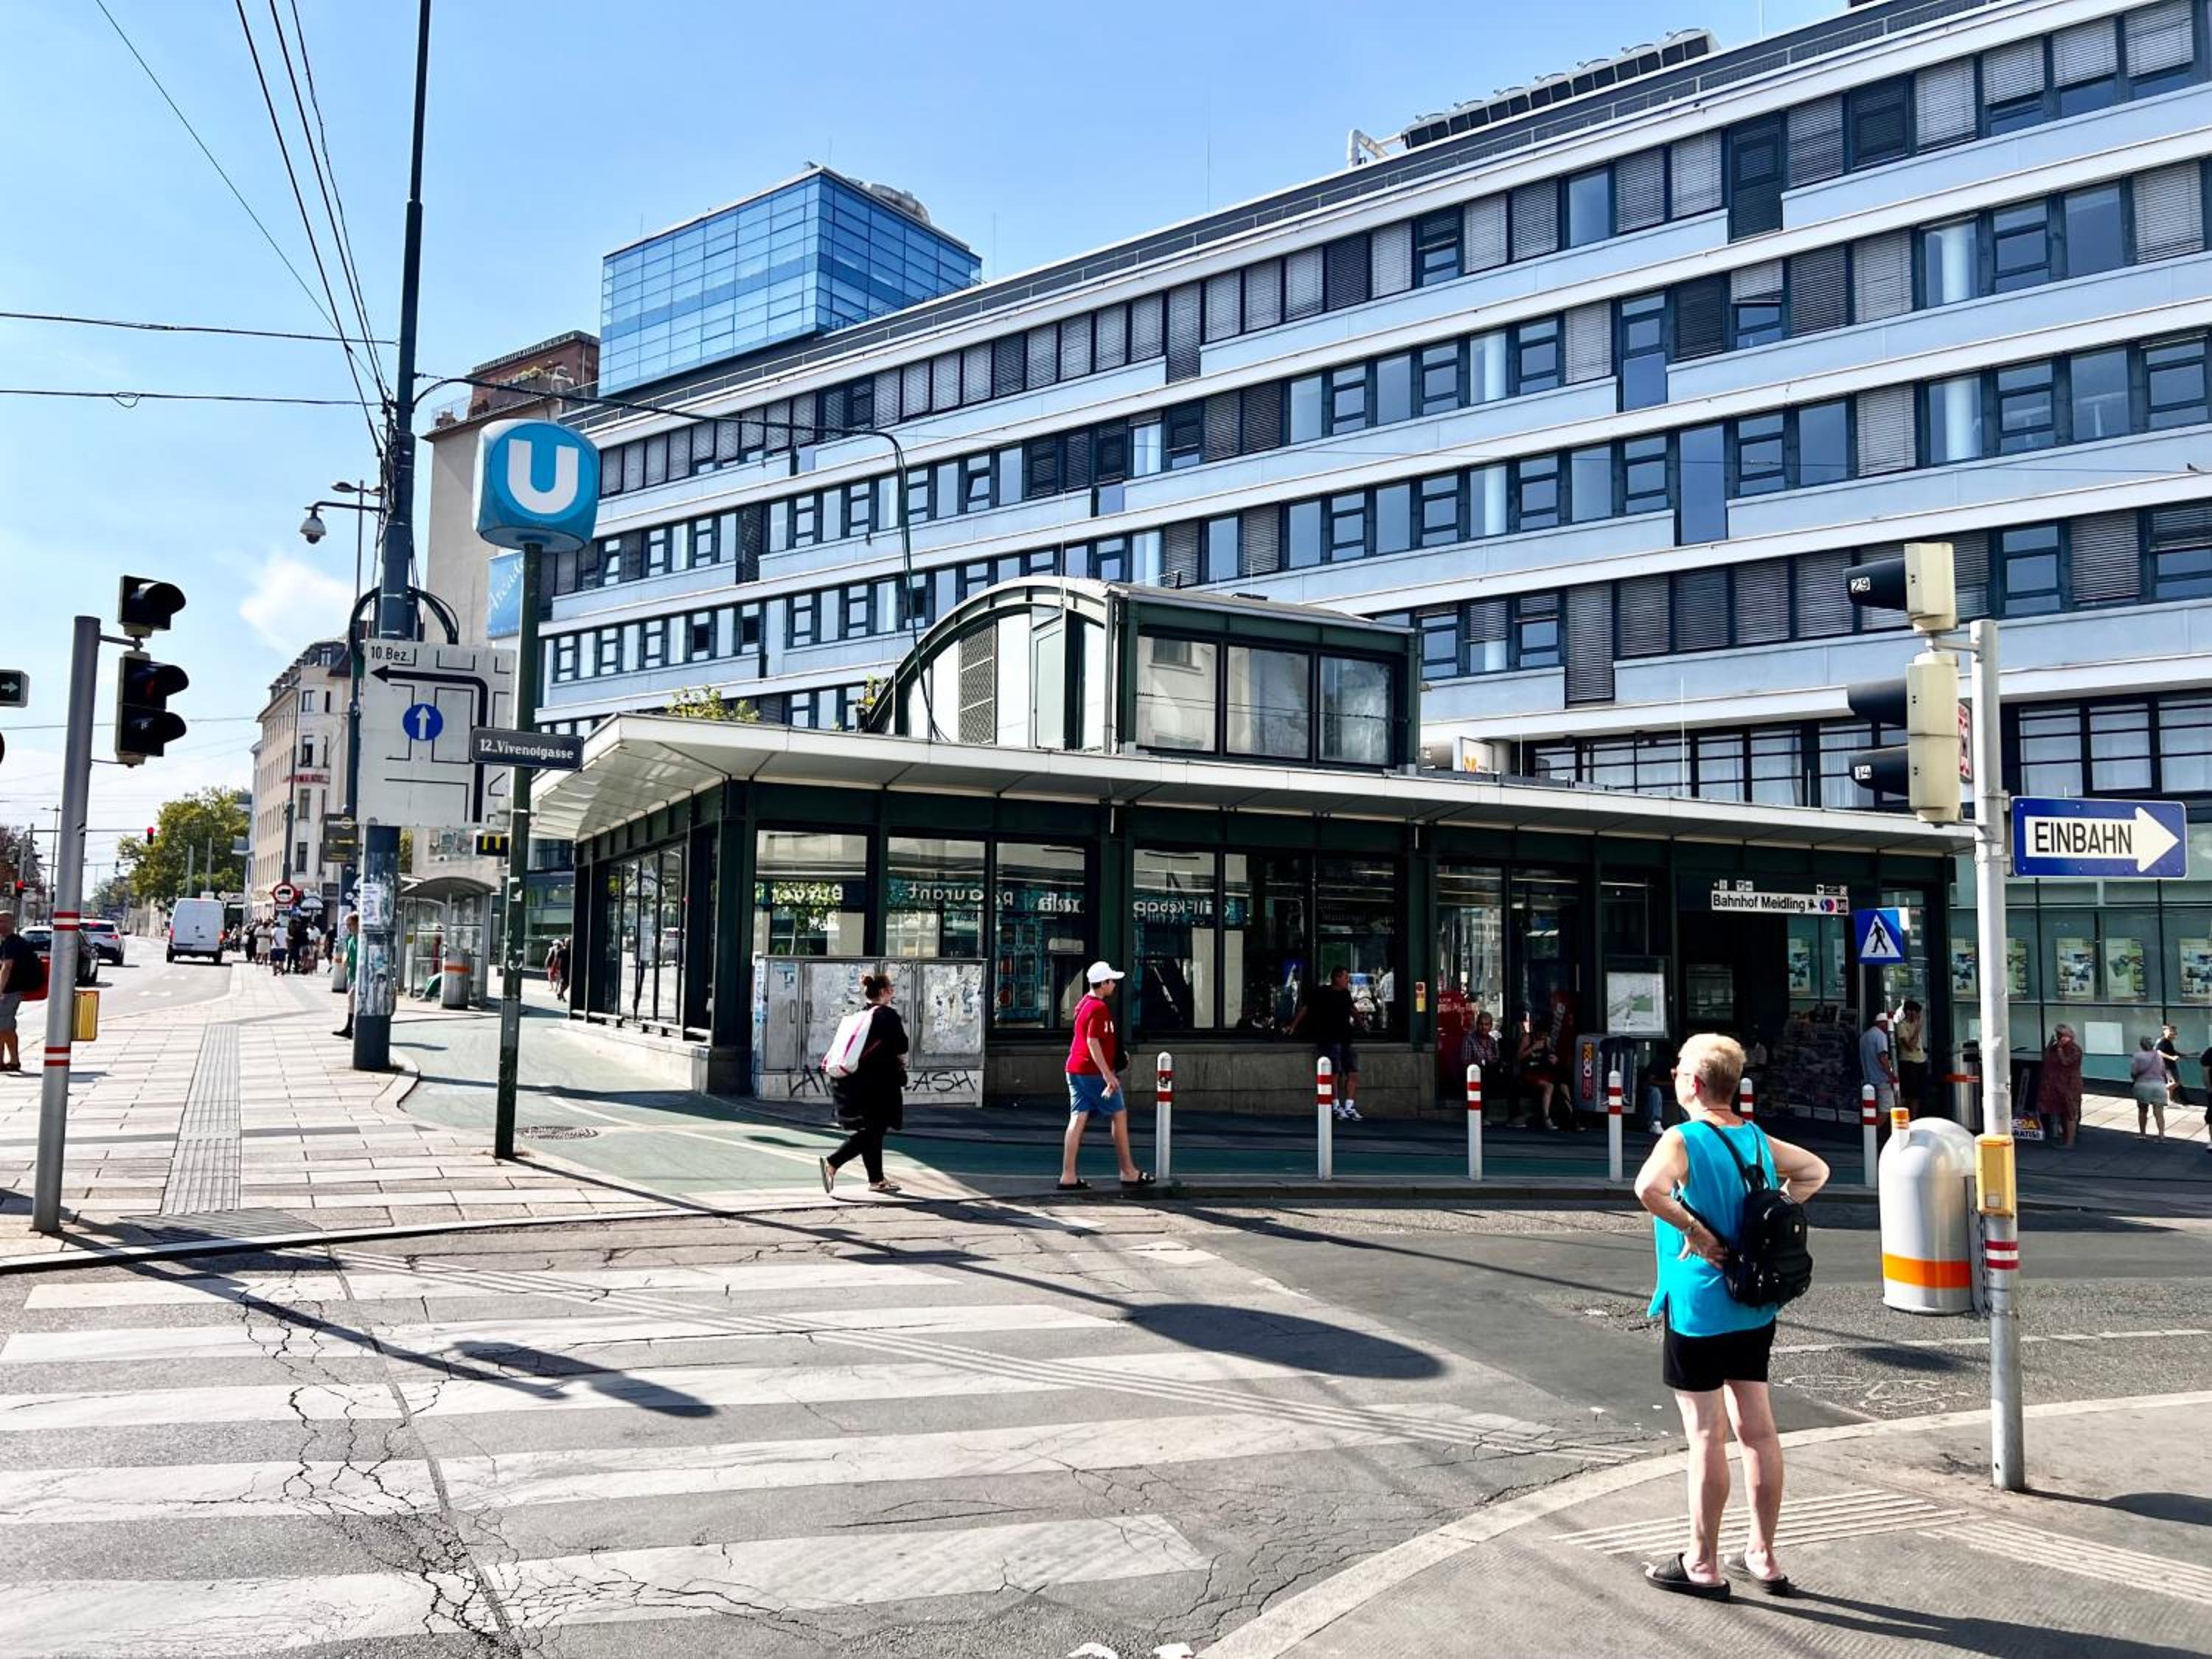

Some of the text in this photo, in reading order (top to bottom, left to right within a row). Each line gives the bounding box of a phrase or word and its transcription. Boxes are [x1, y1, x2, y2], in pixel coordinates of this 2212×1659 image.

[507, 439, 579, 514] U
[2034, 821, 2132, 855] EINBAHN
[1713, 894, 1759, 908] Bahnhof
[1761, 895, 1806, 913] Meidling
